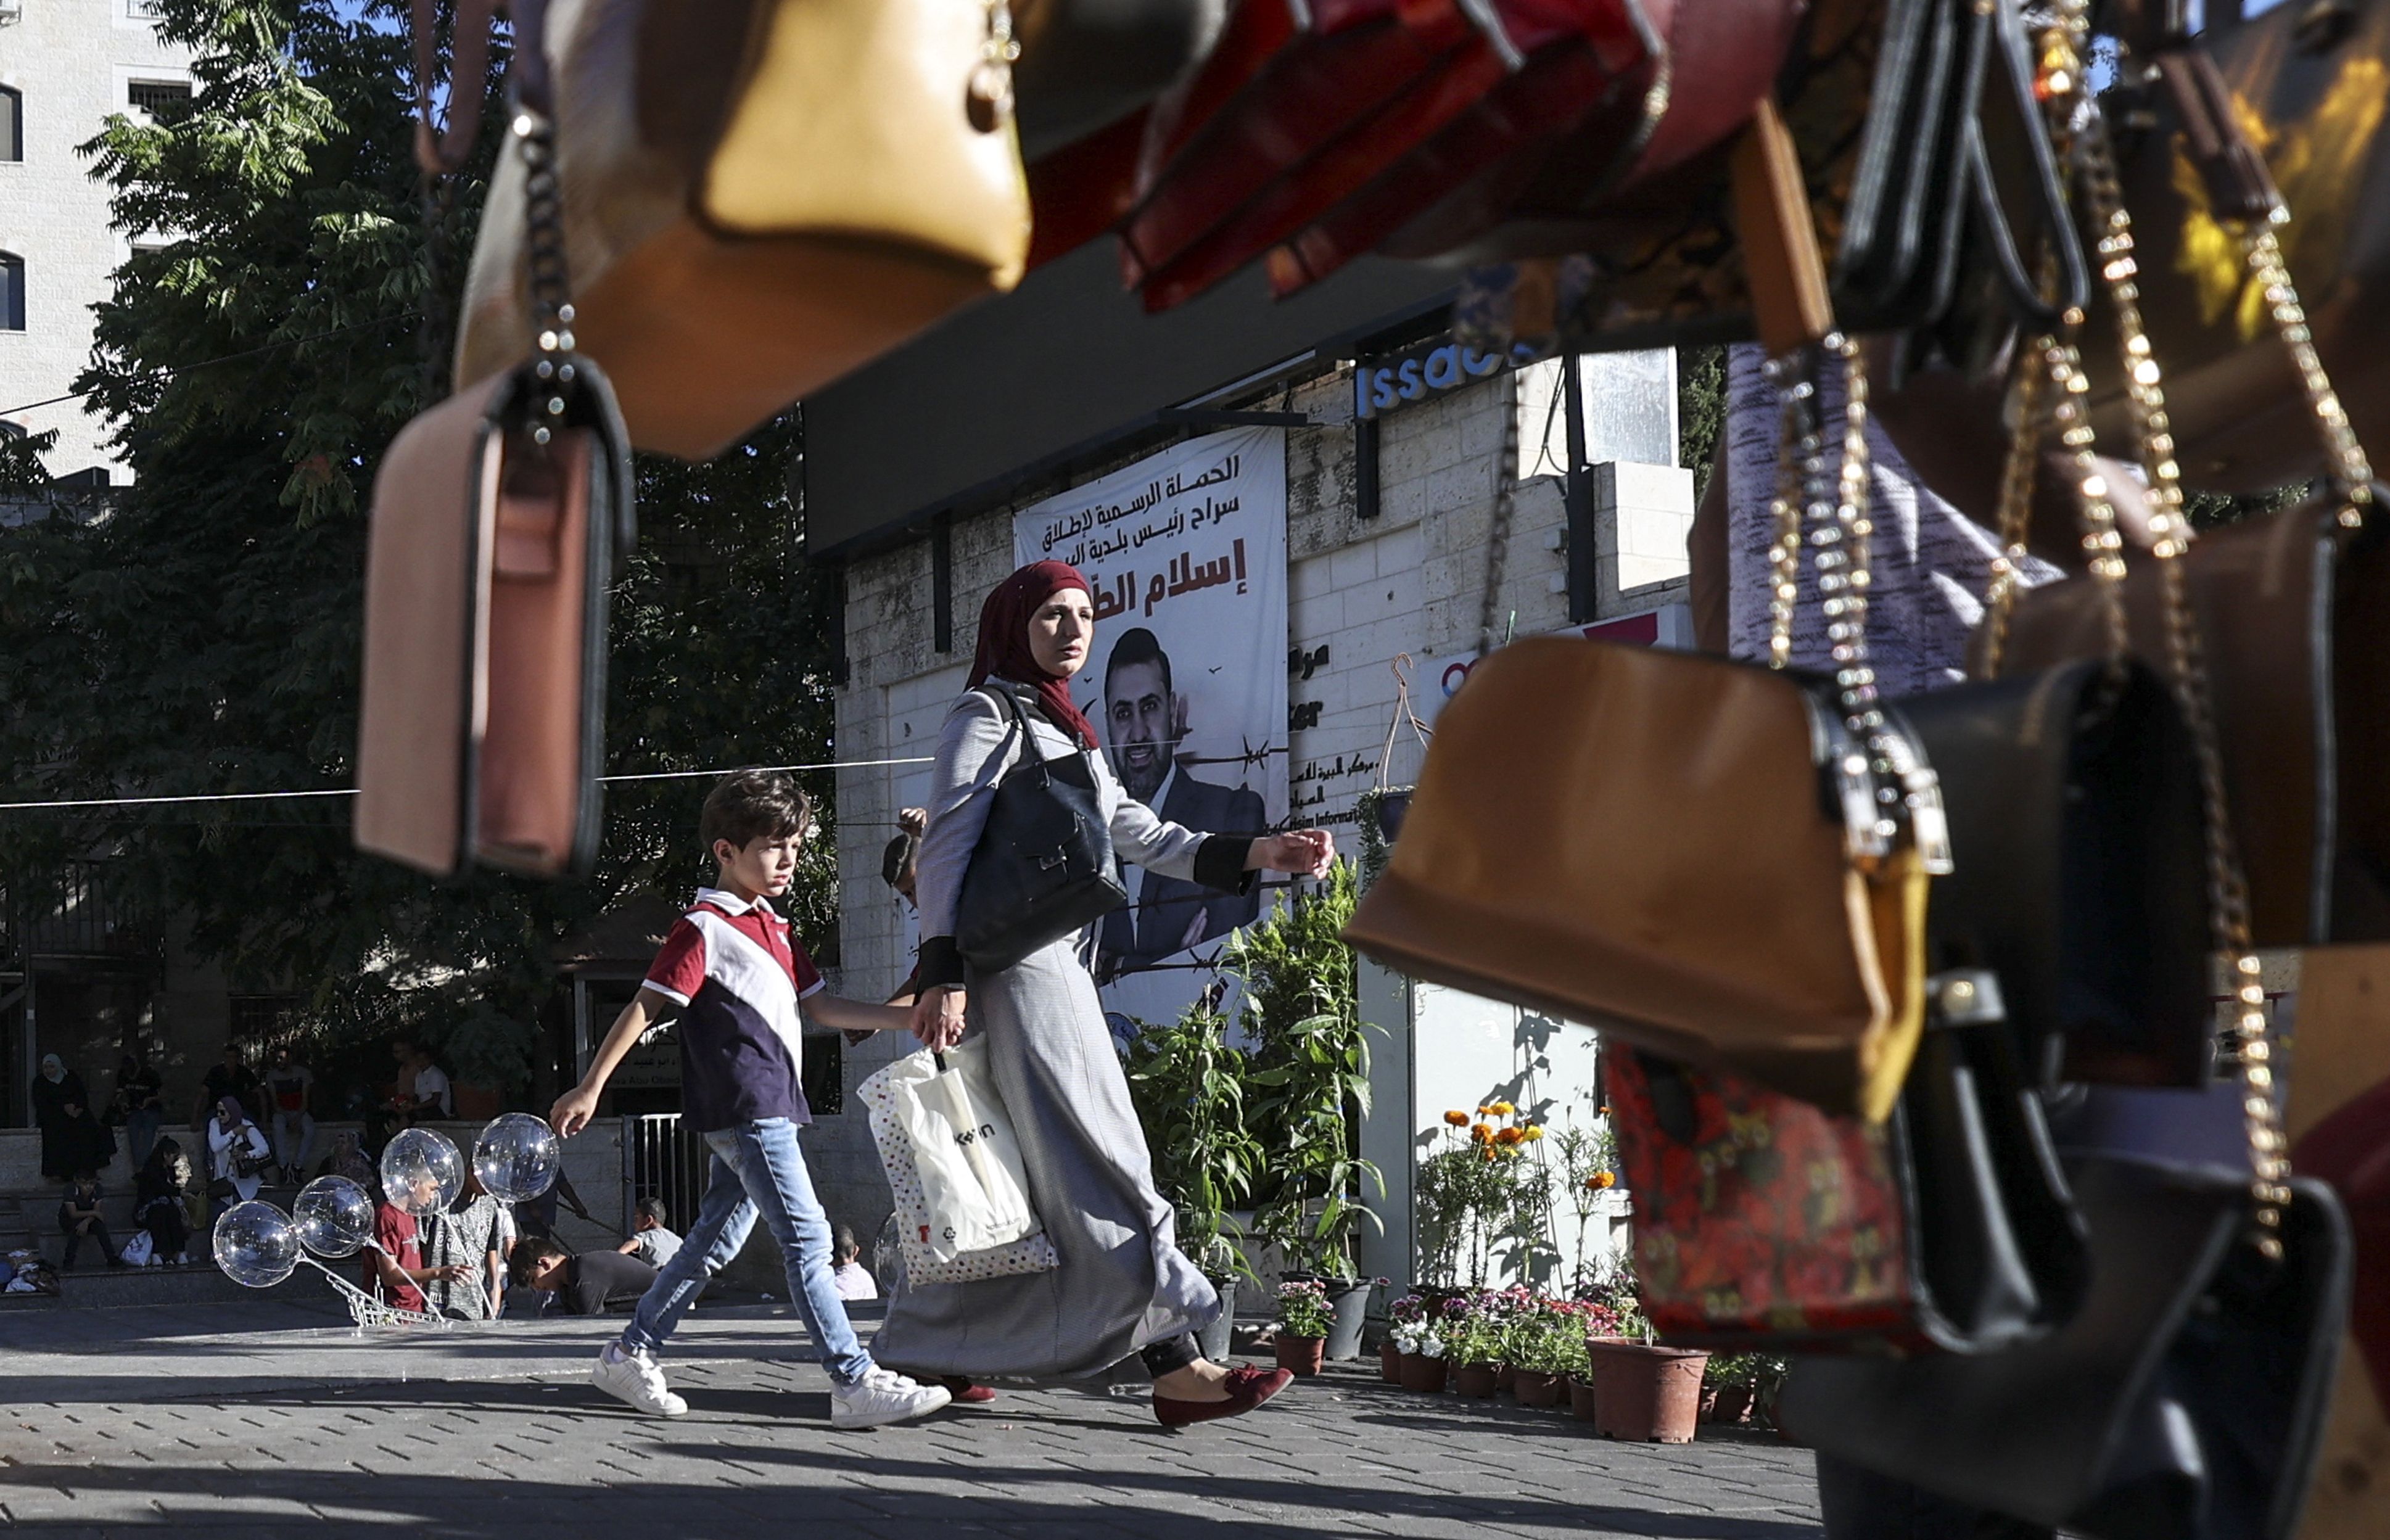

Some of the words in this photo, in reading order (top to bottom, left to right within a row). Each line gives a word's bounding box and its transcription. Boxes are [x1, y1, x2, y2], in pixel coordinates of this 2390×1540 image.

[1166, 455, 1239, 498] الحملة
[1097, 481, 1161, 529] الرسمية
[1191, 496, 1239, 530] سراح
[1042, 509, 1092, 553] لإطلاق
[1089, 528, 1128, 564] بلدية
[1133, 508, 1184, 548] رئيس
[1145, 538, 1247, 617] إسلام
